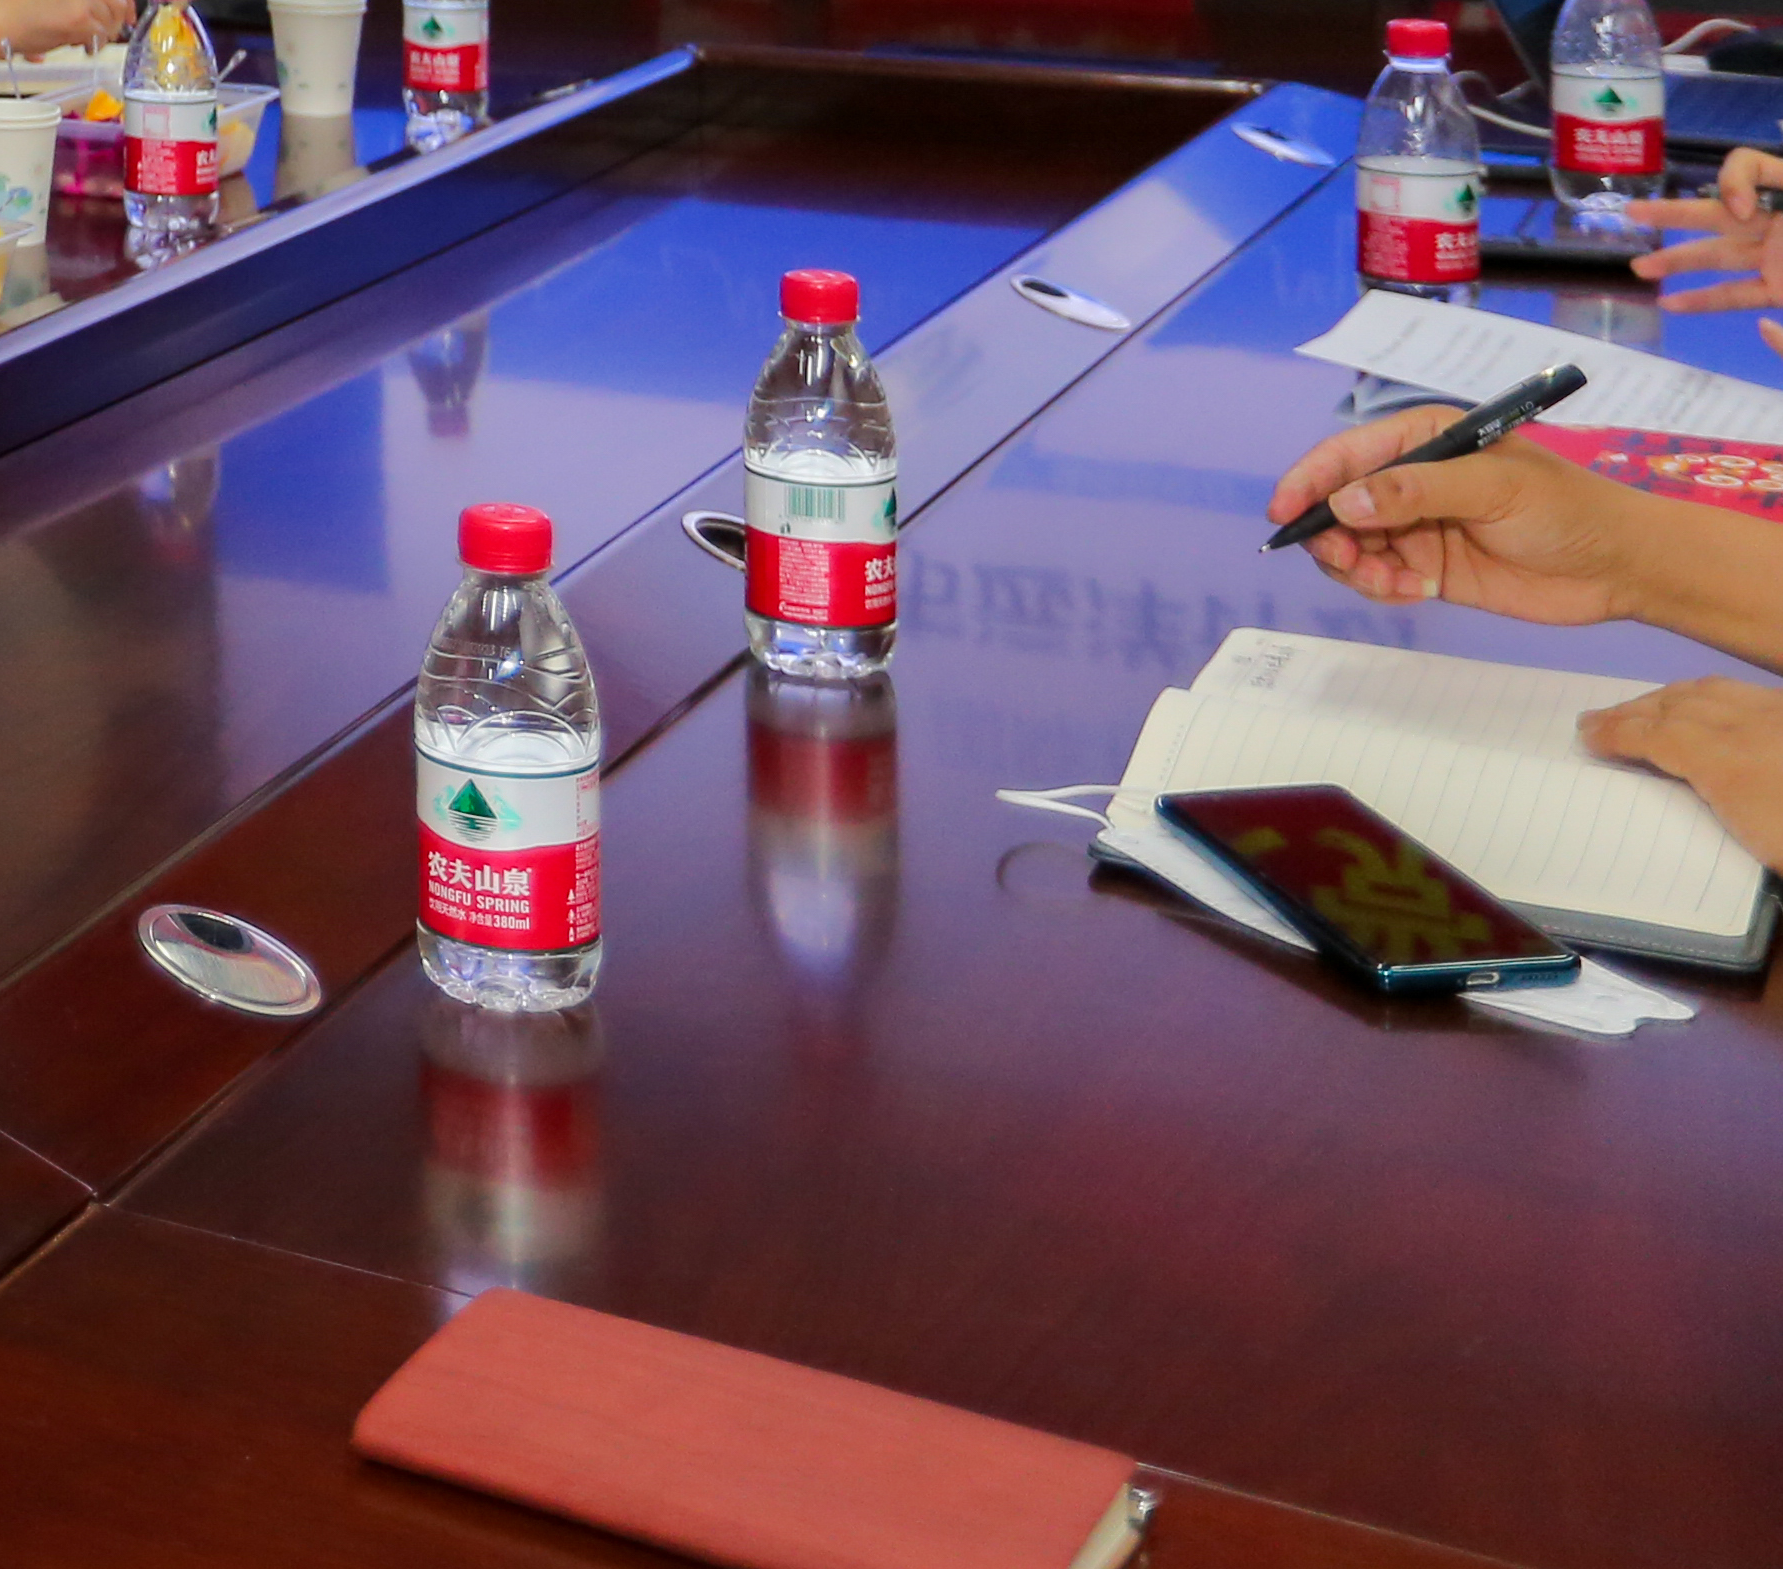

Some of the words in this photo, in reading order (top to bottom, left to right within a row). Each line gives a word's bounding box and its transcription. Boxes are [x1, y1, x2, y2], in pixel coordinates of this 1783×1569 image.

[427, 850, 531, 897] 农夫山泉
[427, 879, 472, 907] NONGFU
[476, 894, 530, 914] SPRING
